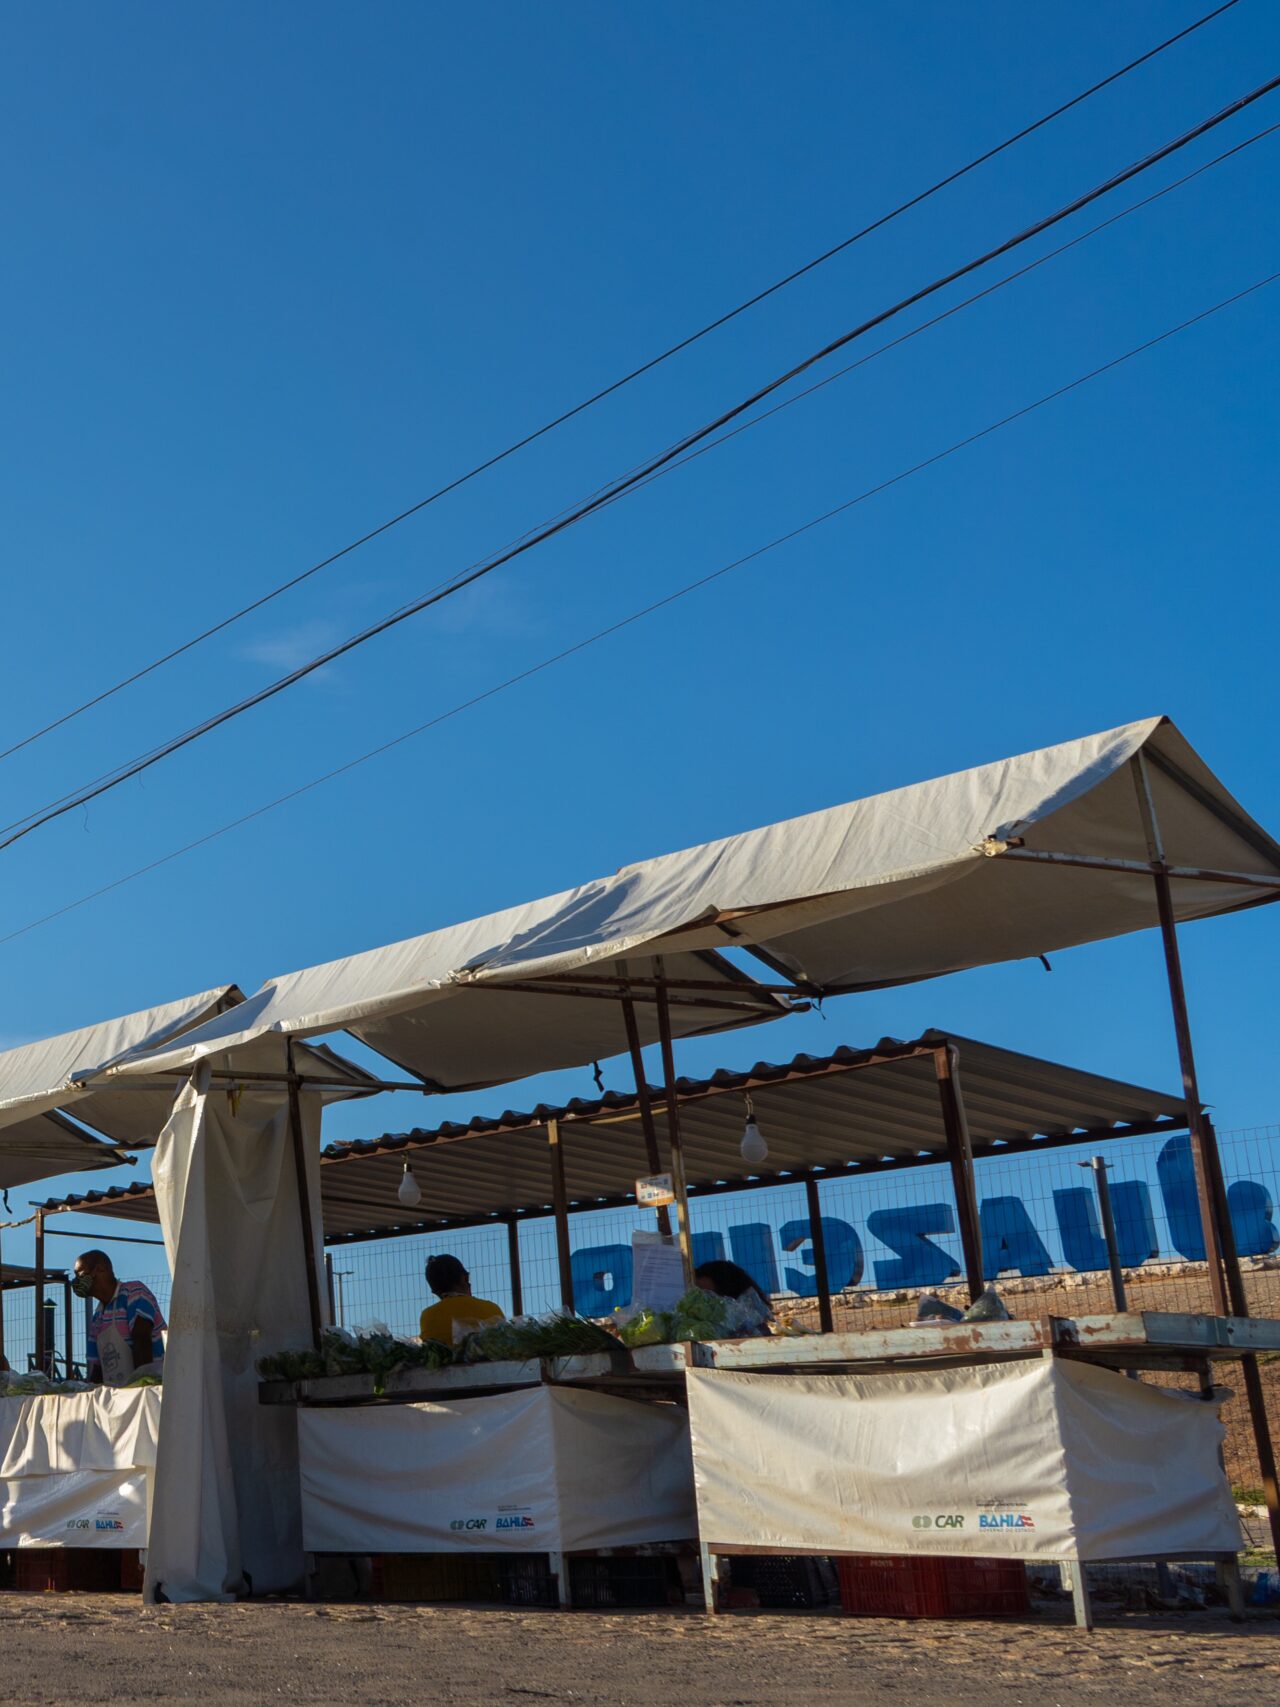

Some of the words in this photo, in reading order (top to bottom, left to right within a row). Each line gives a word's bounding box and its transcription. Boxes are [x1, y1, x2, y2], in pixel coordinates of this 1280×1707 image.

[76, 1519, 90, 1529] CAR
[96, 1519, 123, 1529] BAHIA
[465, 1519, 488, 1530] CAR
[496, 1515, 534, 1529] BAHIA
[935, 1514, 965, 1528] CAR
[979, 1513, 1034, 1527] BAHIA
